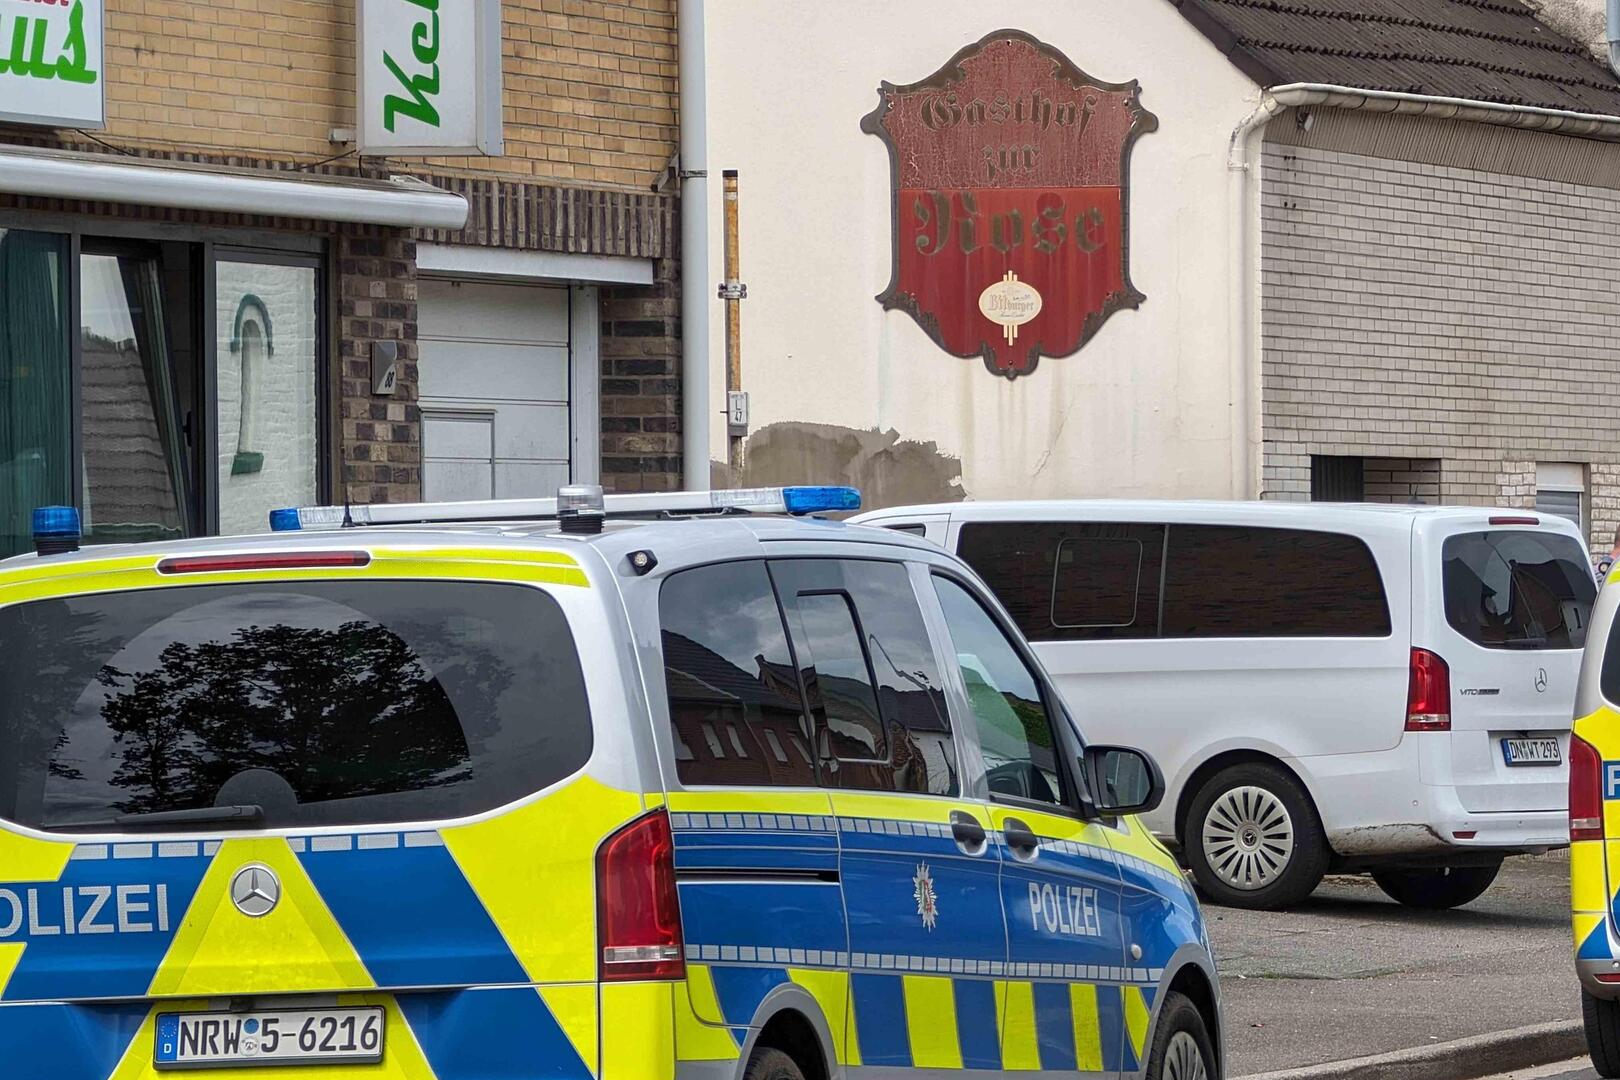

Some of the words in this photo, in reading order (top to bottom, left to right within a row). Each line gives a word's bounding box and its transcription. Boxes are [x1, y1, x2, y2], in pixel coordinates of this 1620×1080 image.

[920, 89, 1098, 140] Gasthof
[981, 144, 1041, 186] zur
[913, 189, 1107, 256] Rose
[1509, 742, 1523, 759] DN
[1528, 741, 1540, 759] WT
[1540, 741, 1559, 759] 293
[1028, 881, 1101, 937] POLIZEI
[179, 1020, 242, 1056] NRW
[261, 1015, 379, 1053] 5-6216
